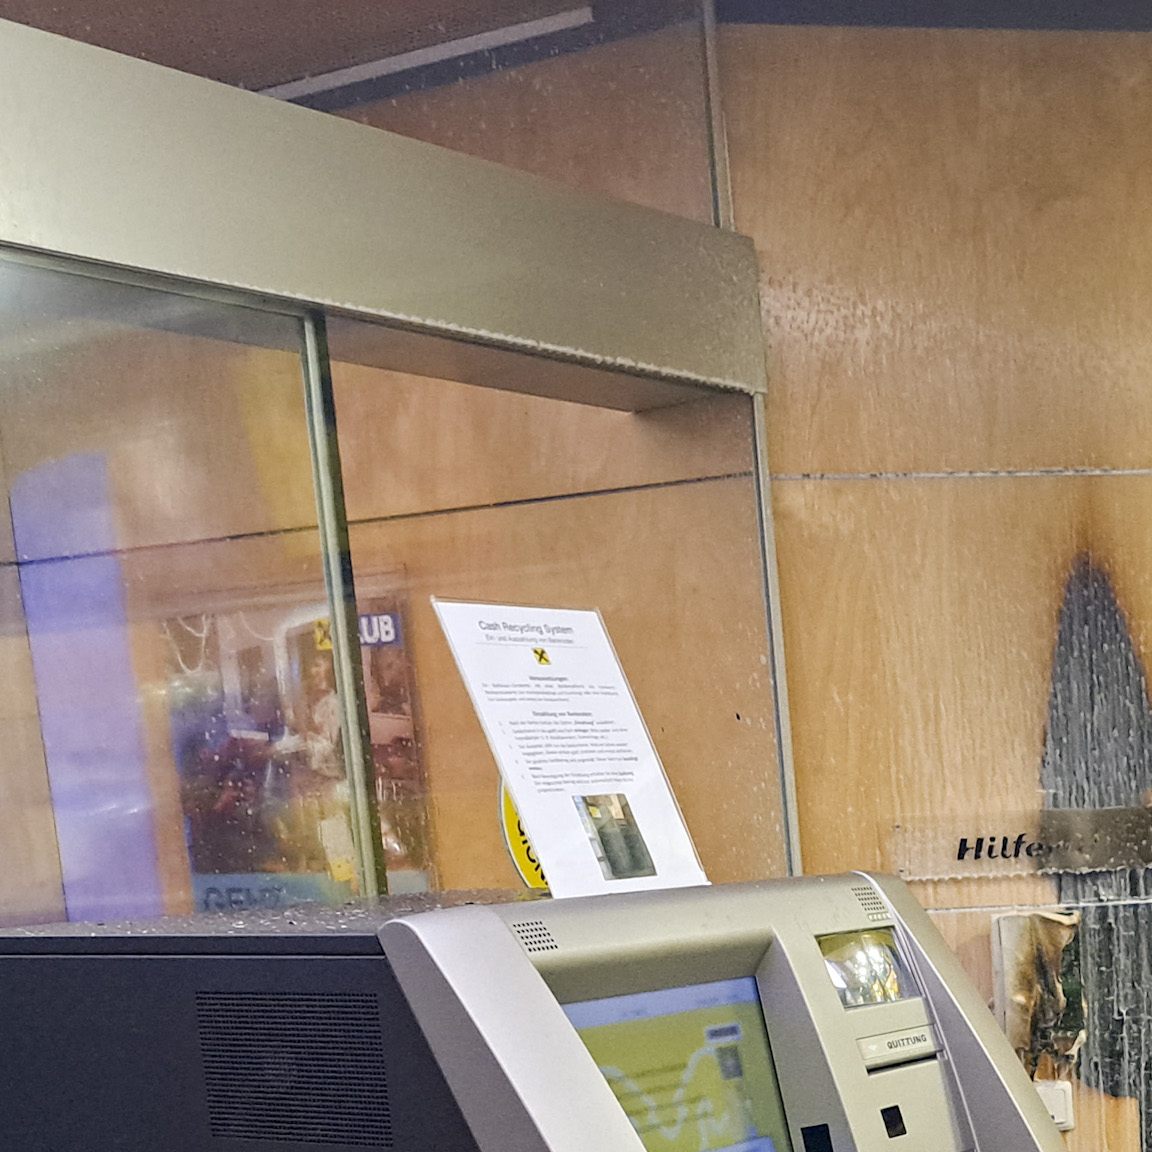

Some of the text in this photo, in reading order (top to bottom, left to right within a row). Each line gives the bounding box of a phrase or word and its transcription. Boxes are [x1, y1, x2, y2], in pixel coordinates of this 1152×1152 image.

[358, 614, 397, 645] UB
[478, 620, 574, 635] Cash Recycling System
[886, 1034, 927, 1049] QUITTUNG
